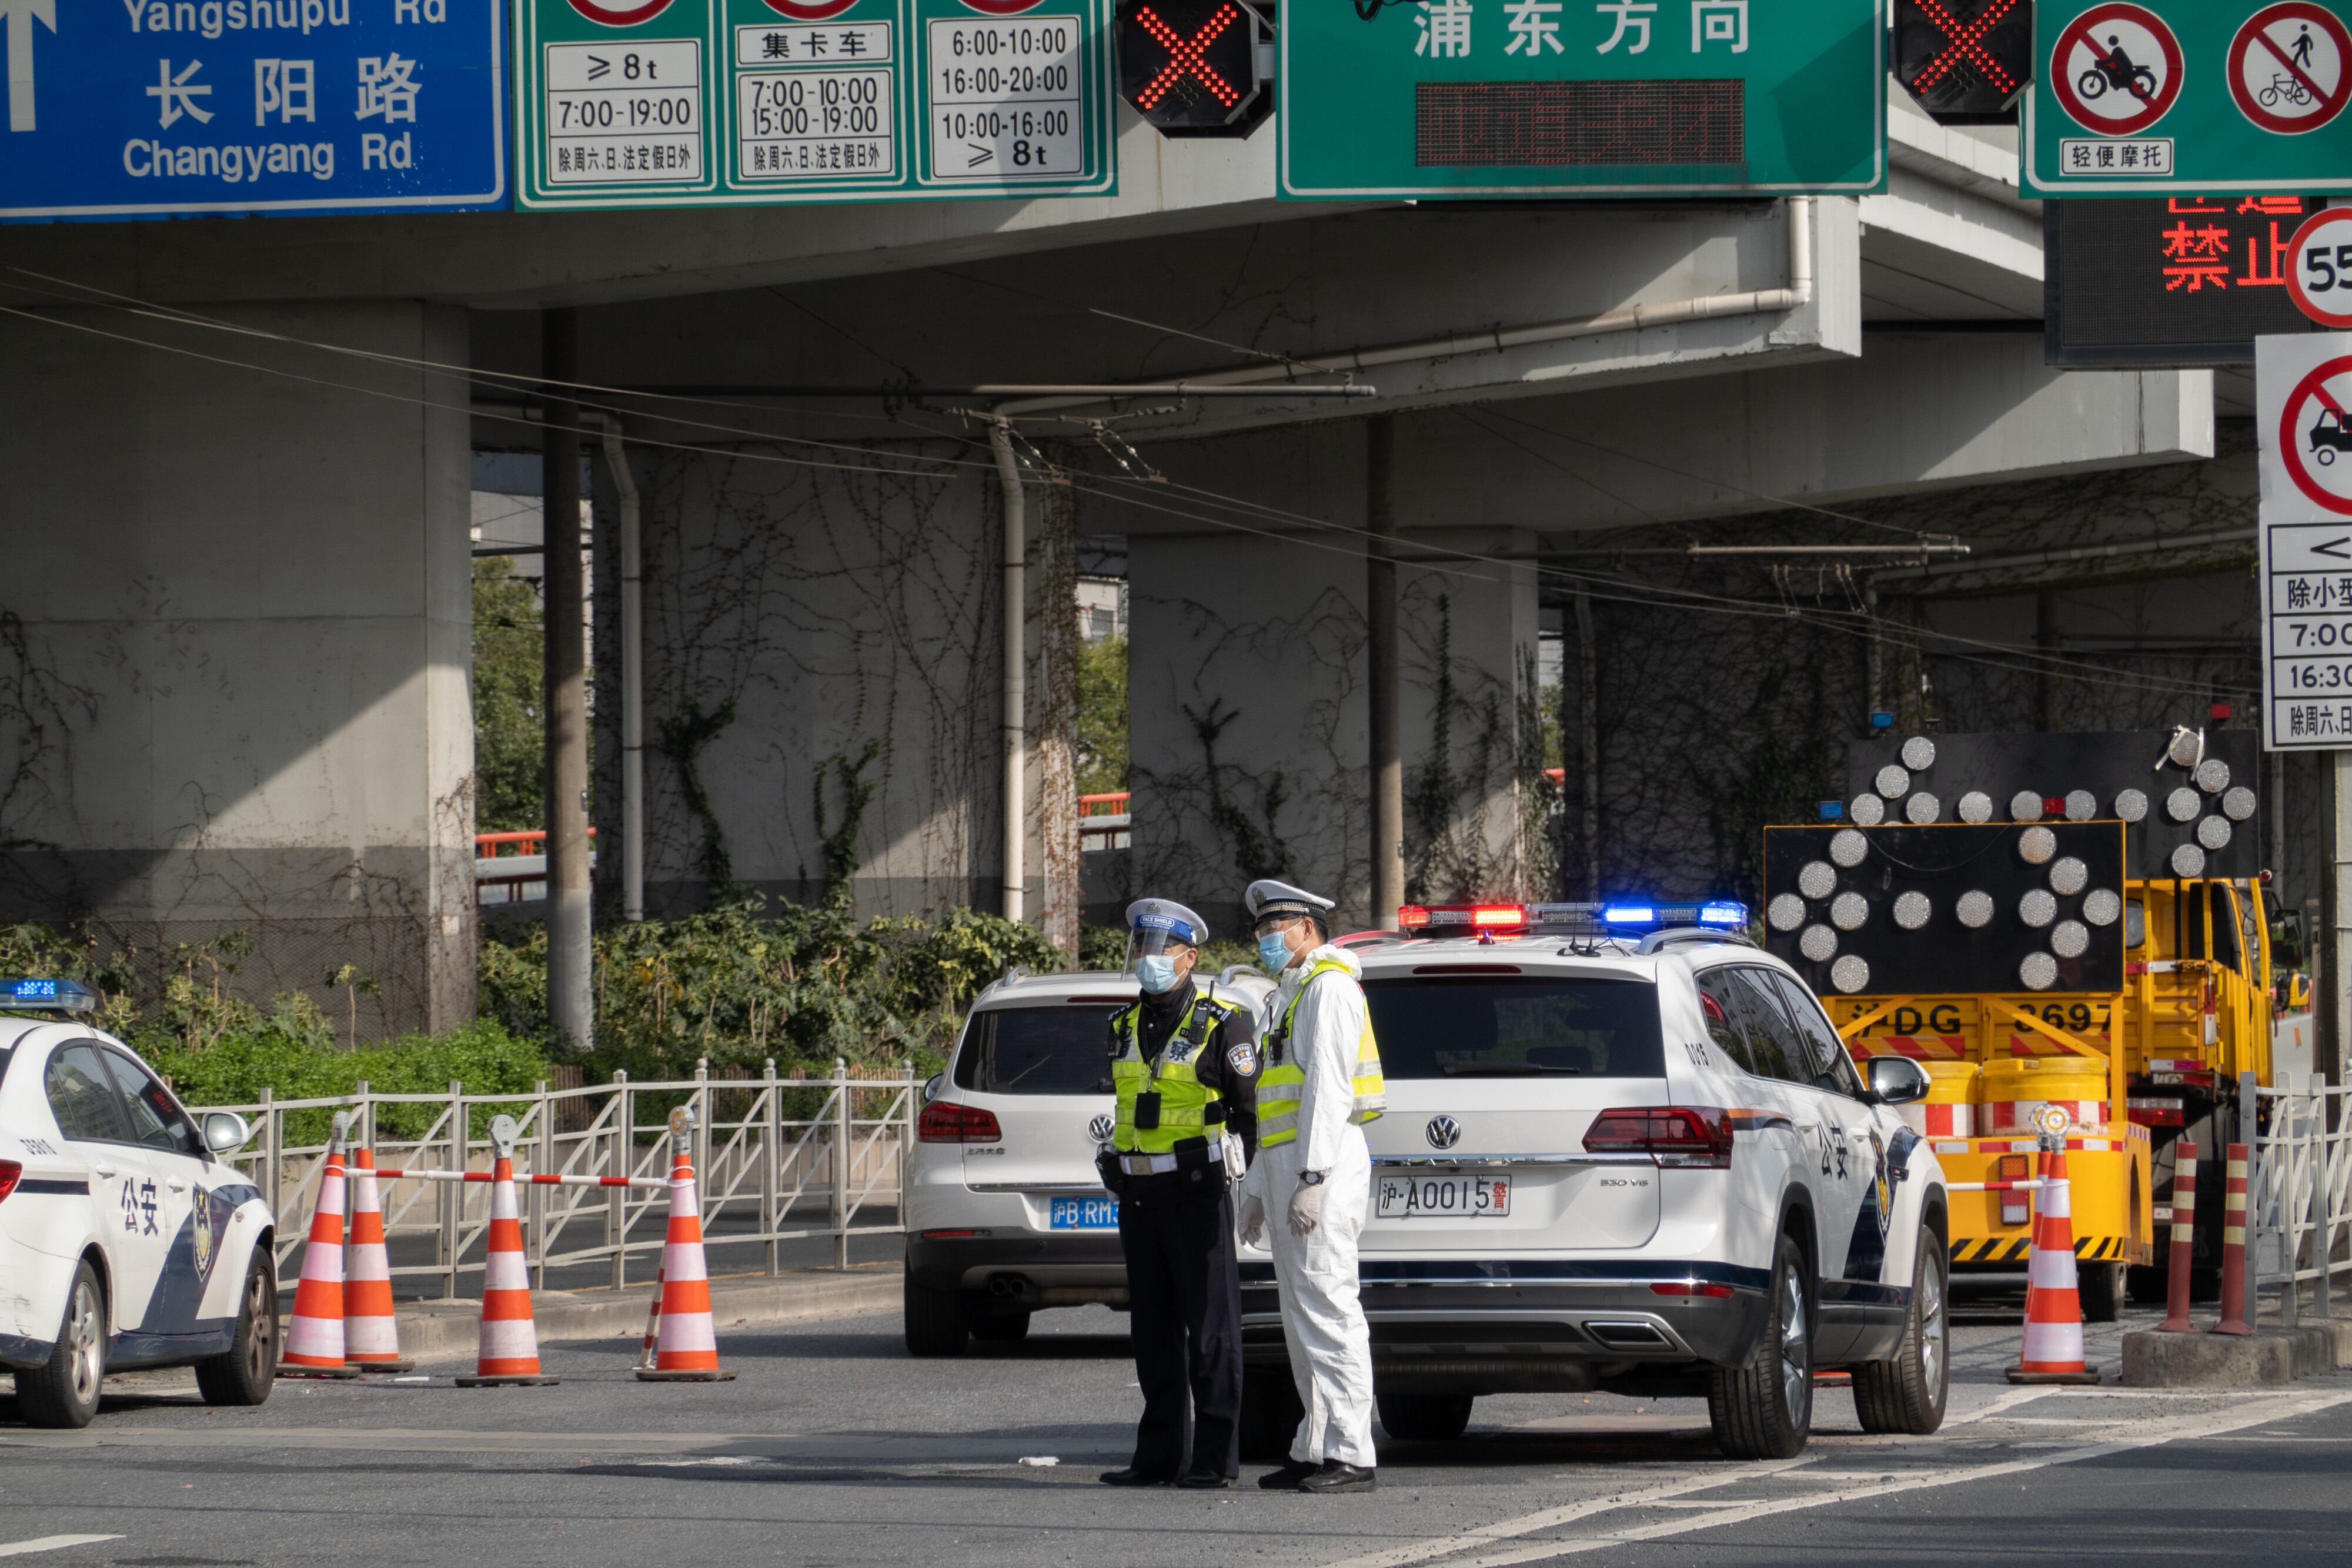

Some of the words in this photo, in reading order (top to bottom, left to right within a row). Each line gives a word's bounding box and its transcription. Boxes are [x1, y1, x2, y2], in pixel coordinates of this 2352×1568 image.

[124, 0, 350, 38] Yangshupu
[395, 0, 446, 24] Rd
[1414, 0, 1749, 58] 浦东方向
[761, 31, 867, 58] 集卡车
[953, 28, 1066, 56] 6:00-10:00
[146, 52, 423, 130] 长阳路
[751, 77, 877, 108] 7:00-10:00
[943, 64, 1068, 94] 16:00-20:00
[559, 98, 690, 128] 7:00-19:00
[753, 106, 878, 136] 15:00-19:00
[943, 109, 1068, 139] 10:00-16:00
[124, 139, 335, 183] Changyang
[362, 132, 413, 170] Rd
[559, 143, 690, 172] 除周六、日、法定假日外
[754, 142, 880, 171] 除周六、日、法定假日外
[2072, 145, 2161, 168] 轻便摩托
[2162, 220, 2288, 293] 禁止
[1685, 1043, 1709, 1066] 0015
[1817, 1121, 1849, 1181] 公安
[121, 1177, 158, 1236] 公安
